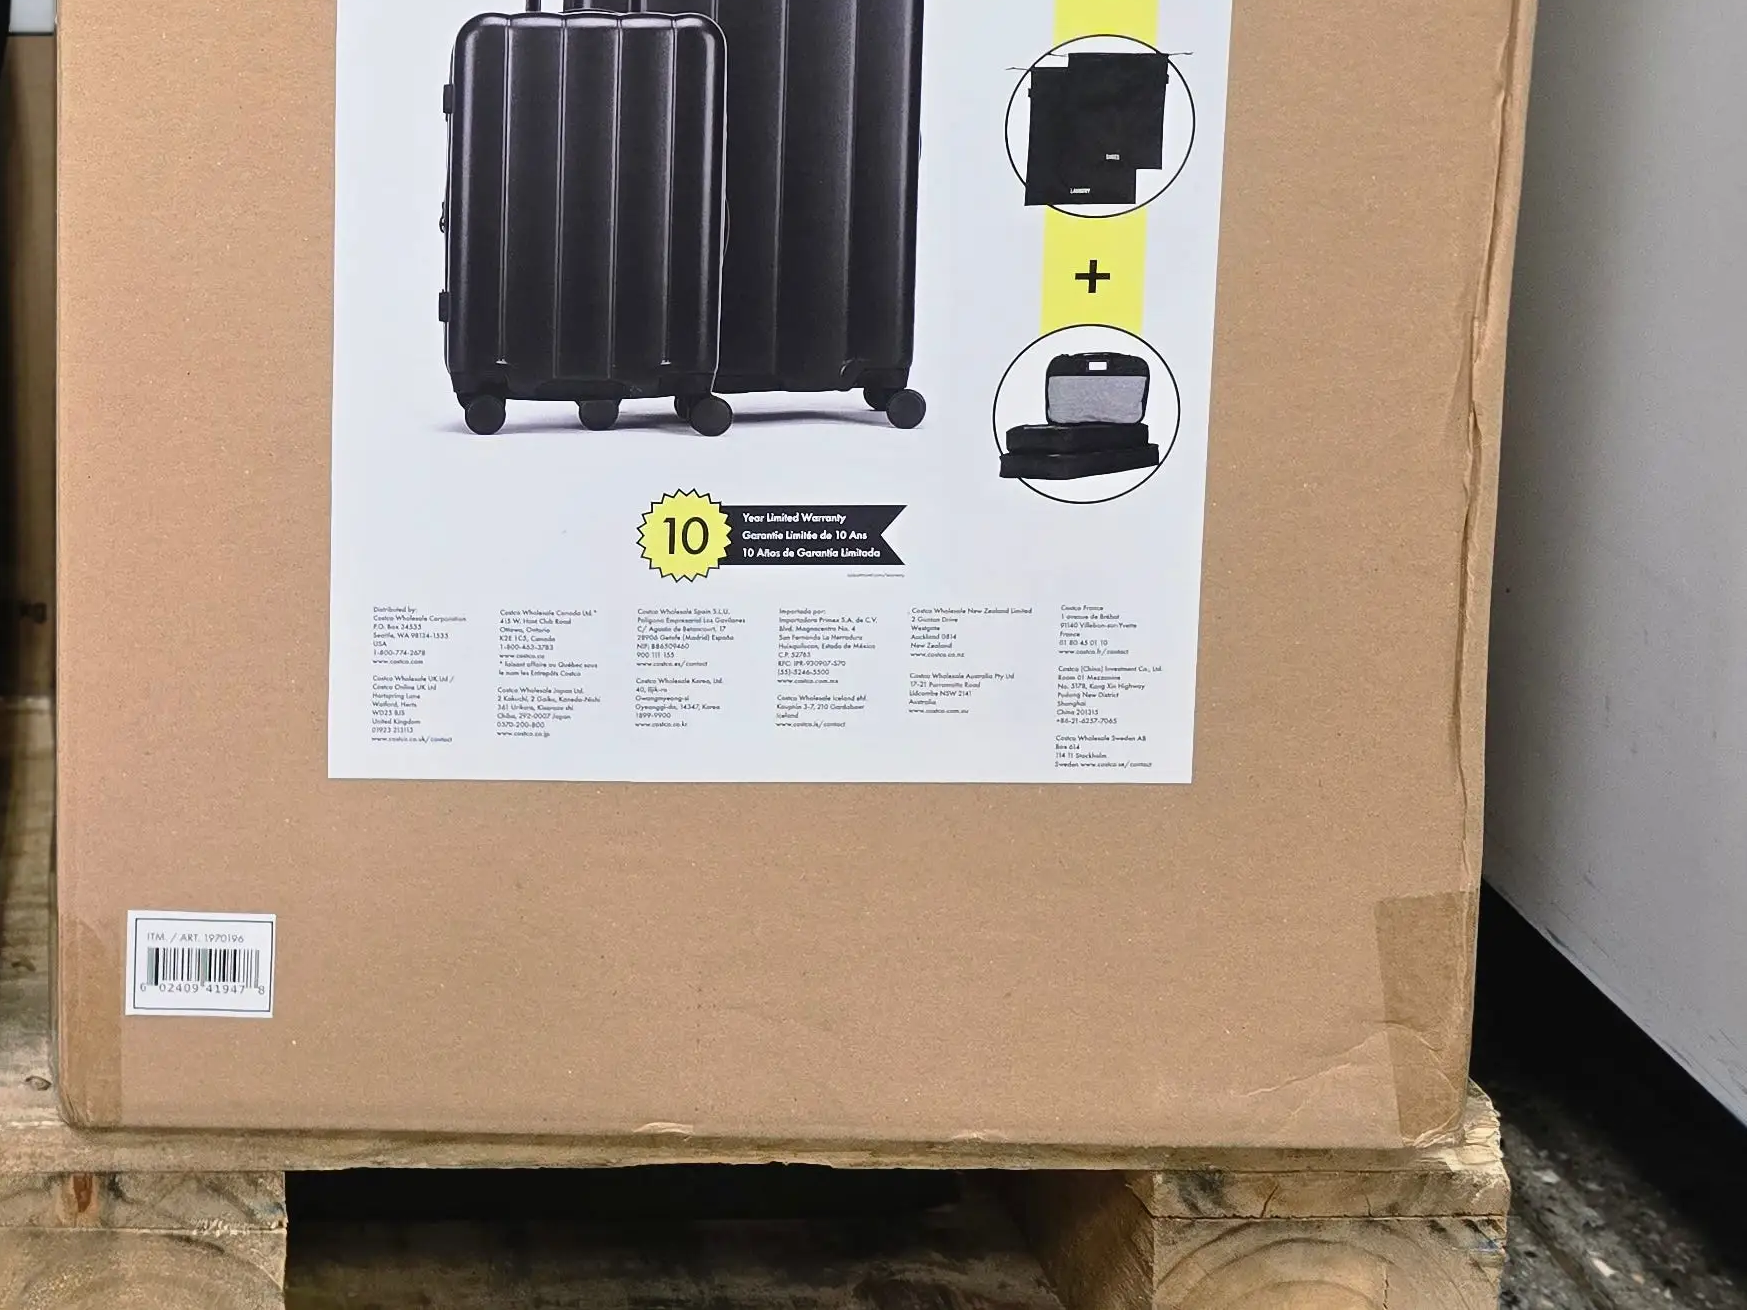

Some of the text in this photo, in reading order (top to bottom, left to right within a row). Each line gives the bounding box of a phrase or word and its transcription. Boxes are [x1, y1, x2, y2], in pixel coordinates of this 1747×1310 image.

[743, 512, 846, 524] Year Limited Warranty
[663, 517, 709, 555] 10
[742, 530, 867, 539] Garantie Limitée de 10 Ans
[743, 547, 754, 558] 10
[756, 548, 780, 557] Años
[783, 547, 794, 557] de
[841, 547, 880, 557] Limitada
[205, 934, 244, 943] 1970196
[159, 983, 198, 993] 02409
[206, 984, 245, 993] 41947
[258, 986, 265, 995] 8
